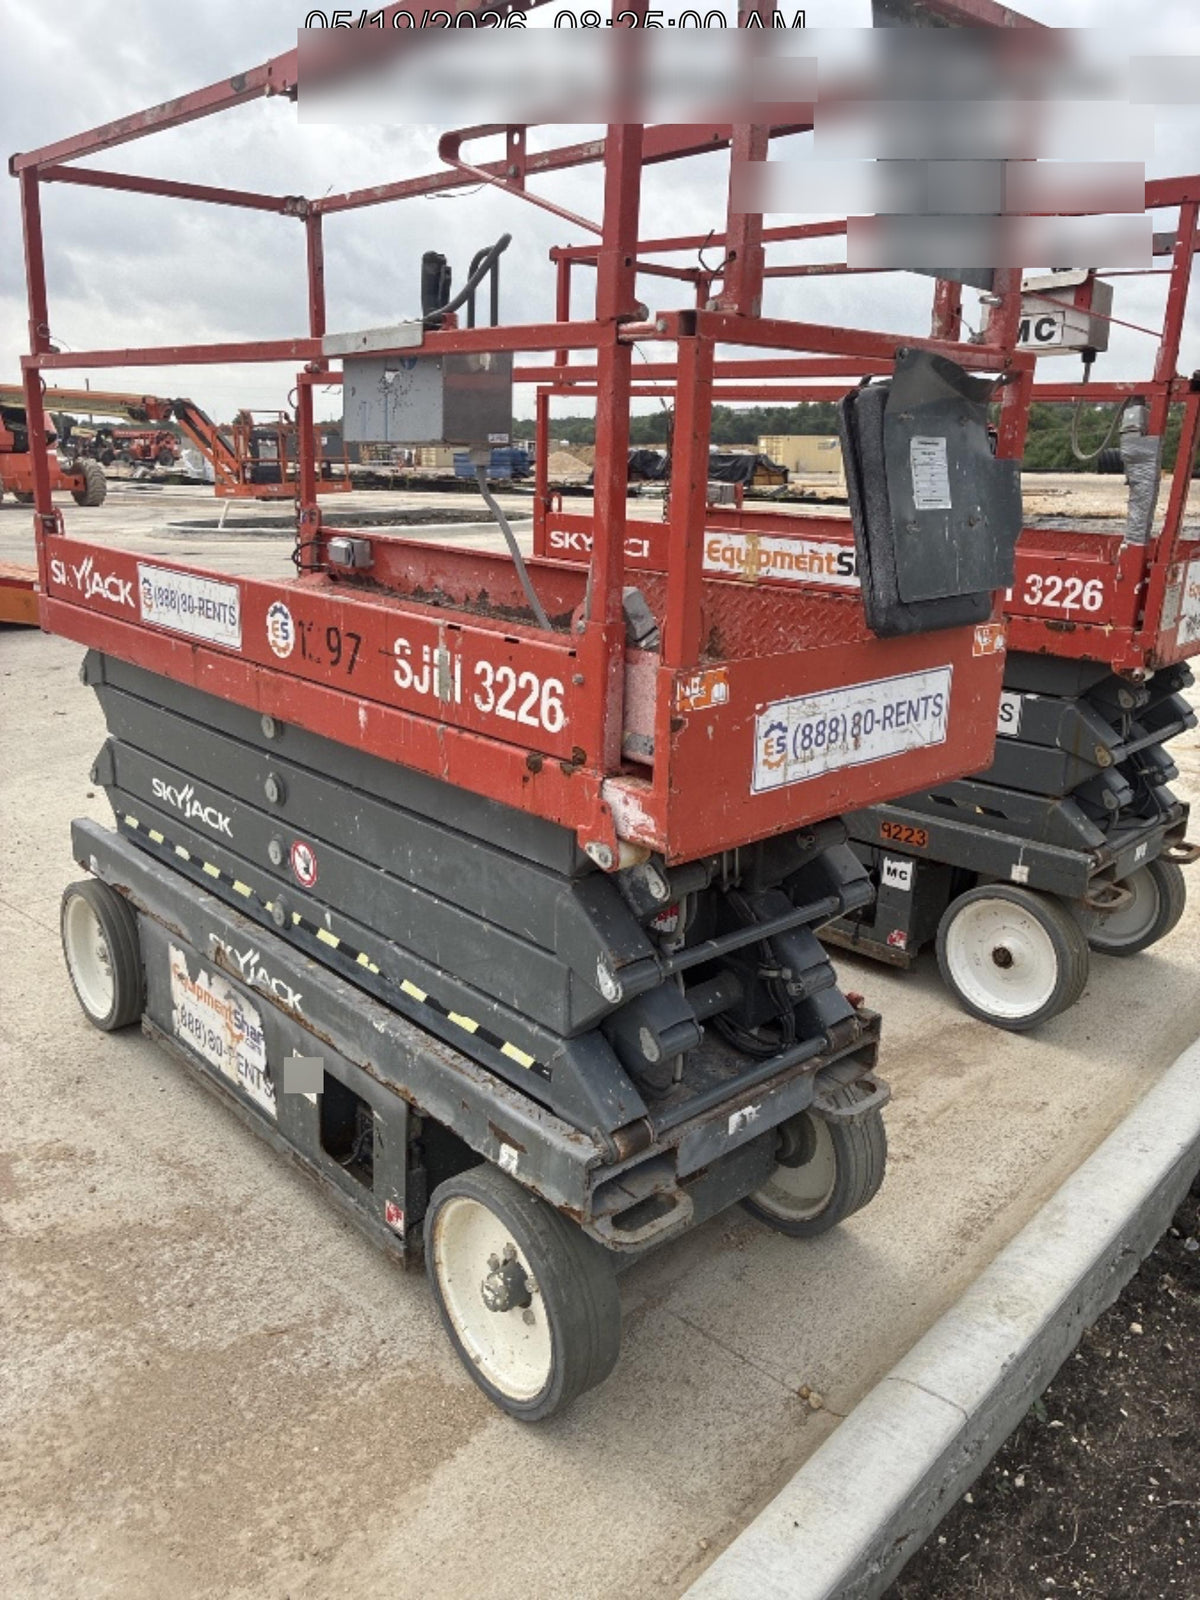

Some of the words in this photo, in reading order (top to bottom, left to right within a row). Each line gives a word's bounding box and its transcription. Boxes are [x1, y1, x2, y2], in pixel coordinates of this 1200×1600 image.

[707, 539, 859, 577] EquipmentS
[1023, 573, 1104, 611] 3226
[298, 620, 362, 675] 197
[473, 660, 566, 734] 3226
[152, 778, 234, 838] SKYJACK
[881, 822, 927, 847] 9223
